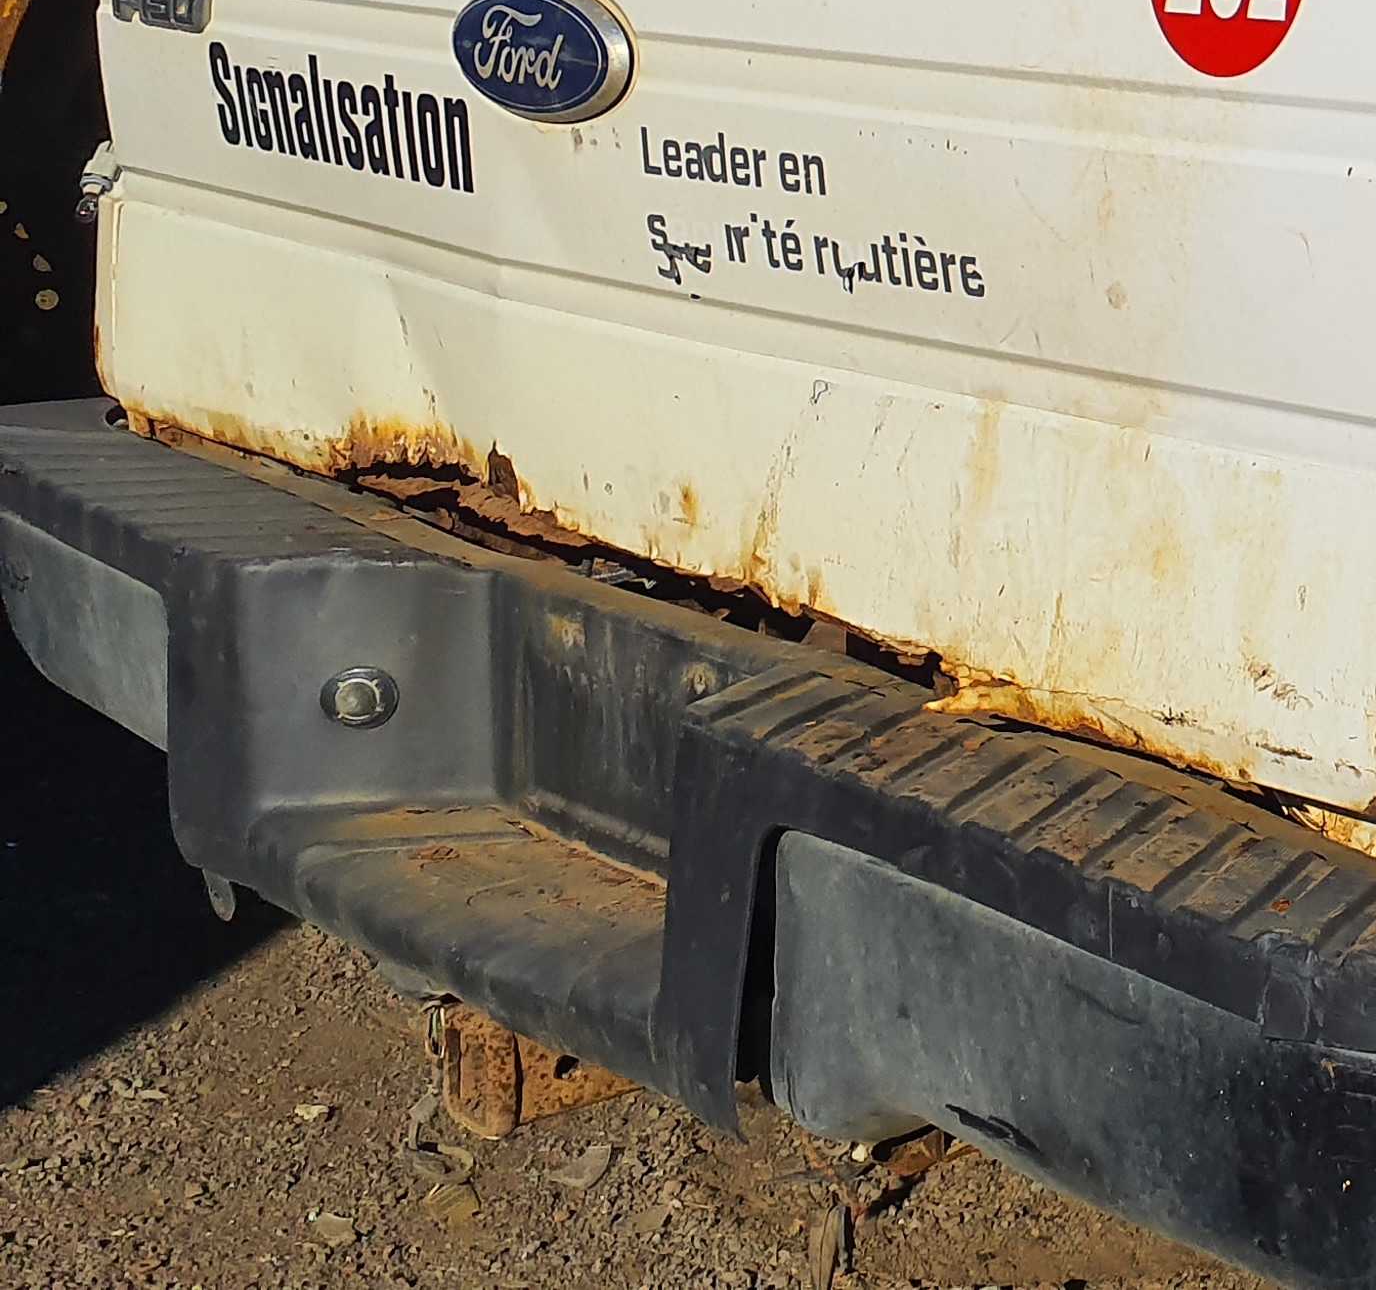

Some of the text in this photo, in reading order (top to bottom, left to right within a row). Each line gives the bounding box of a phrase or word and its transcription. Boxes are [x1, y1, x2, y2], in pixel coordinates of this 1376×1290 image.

[473, 6, 563, 91] Ford
[208, 41, 474, 193] Signalisation
[640, 126, 826, 196] Leader en
